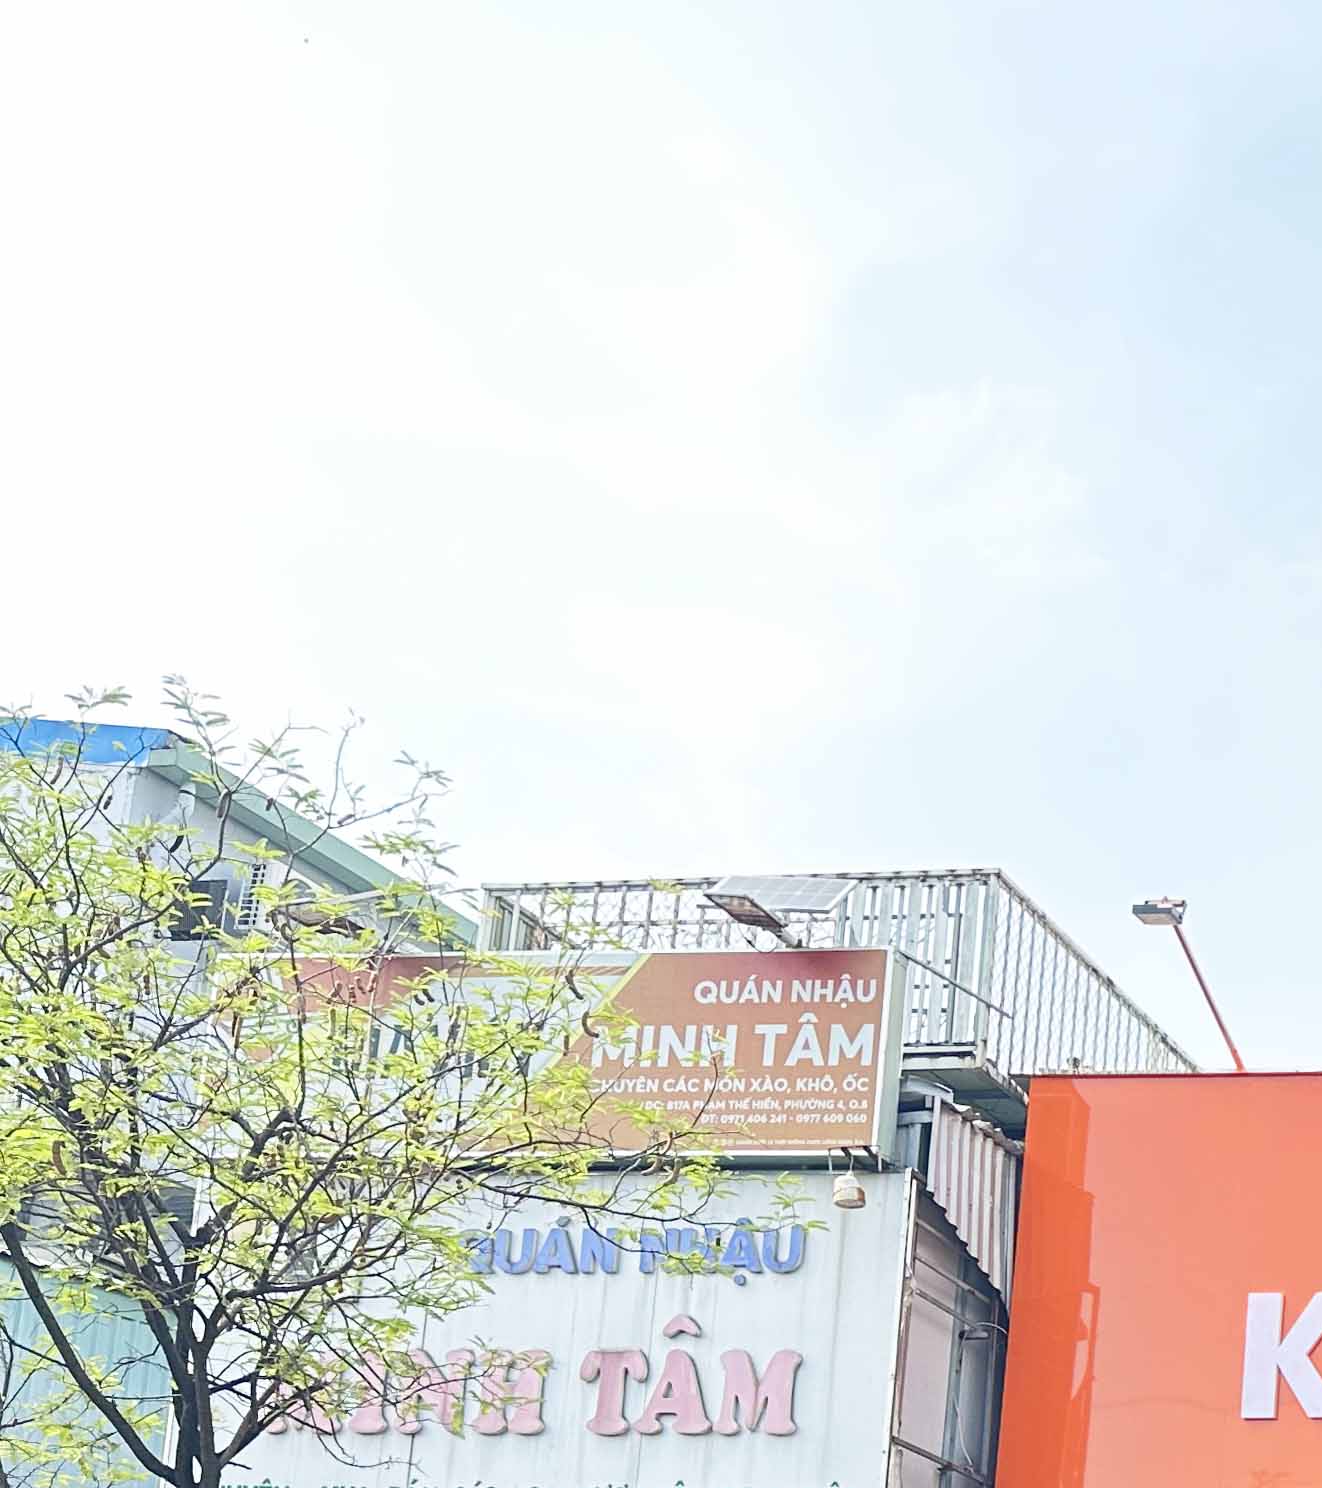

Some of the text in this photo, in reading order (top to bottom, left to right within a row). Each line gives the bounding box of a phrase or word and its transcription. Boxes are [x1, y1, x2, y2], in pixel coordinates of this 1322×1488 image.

[694, 974, 878, 1009] QUÁN NHẬU
[590, 1012, 875, 1068] MINH TÂM
[663, 1074, 698, 1094] CÁC
[703, 1074, 746, 1094] MÓN
[751, 1074, 791, 1095] XÀO,
[796, 1074, 837, 1095] KHÔ,
[843, 1071, 869, 1094] ỐC
[770, 1114, 787, 1124] 241
[796, 1113, 819, 1124] 0977
[822, 1113, 843, 1124] 609
[580, 1314, 802, 1437] TÂM
